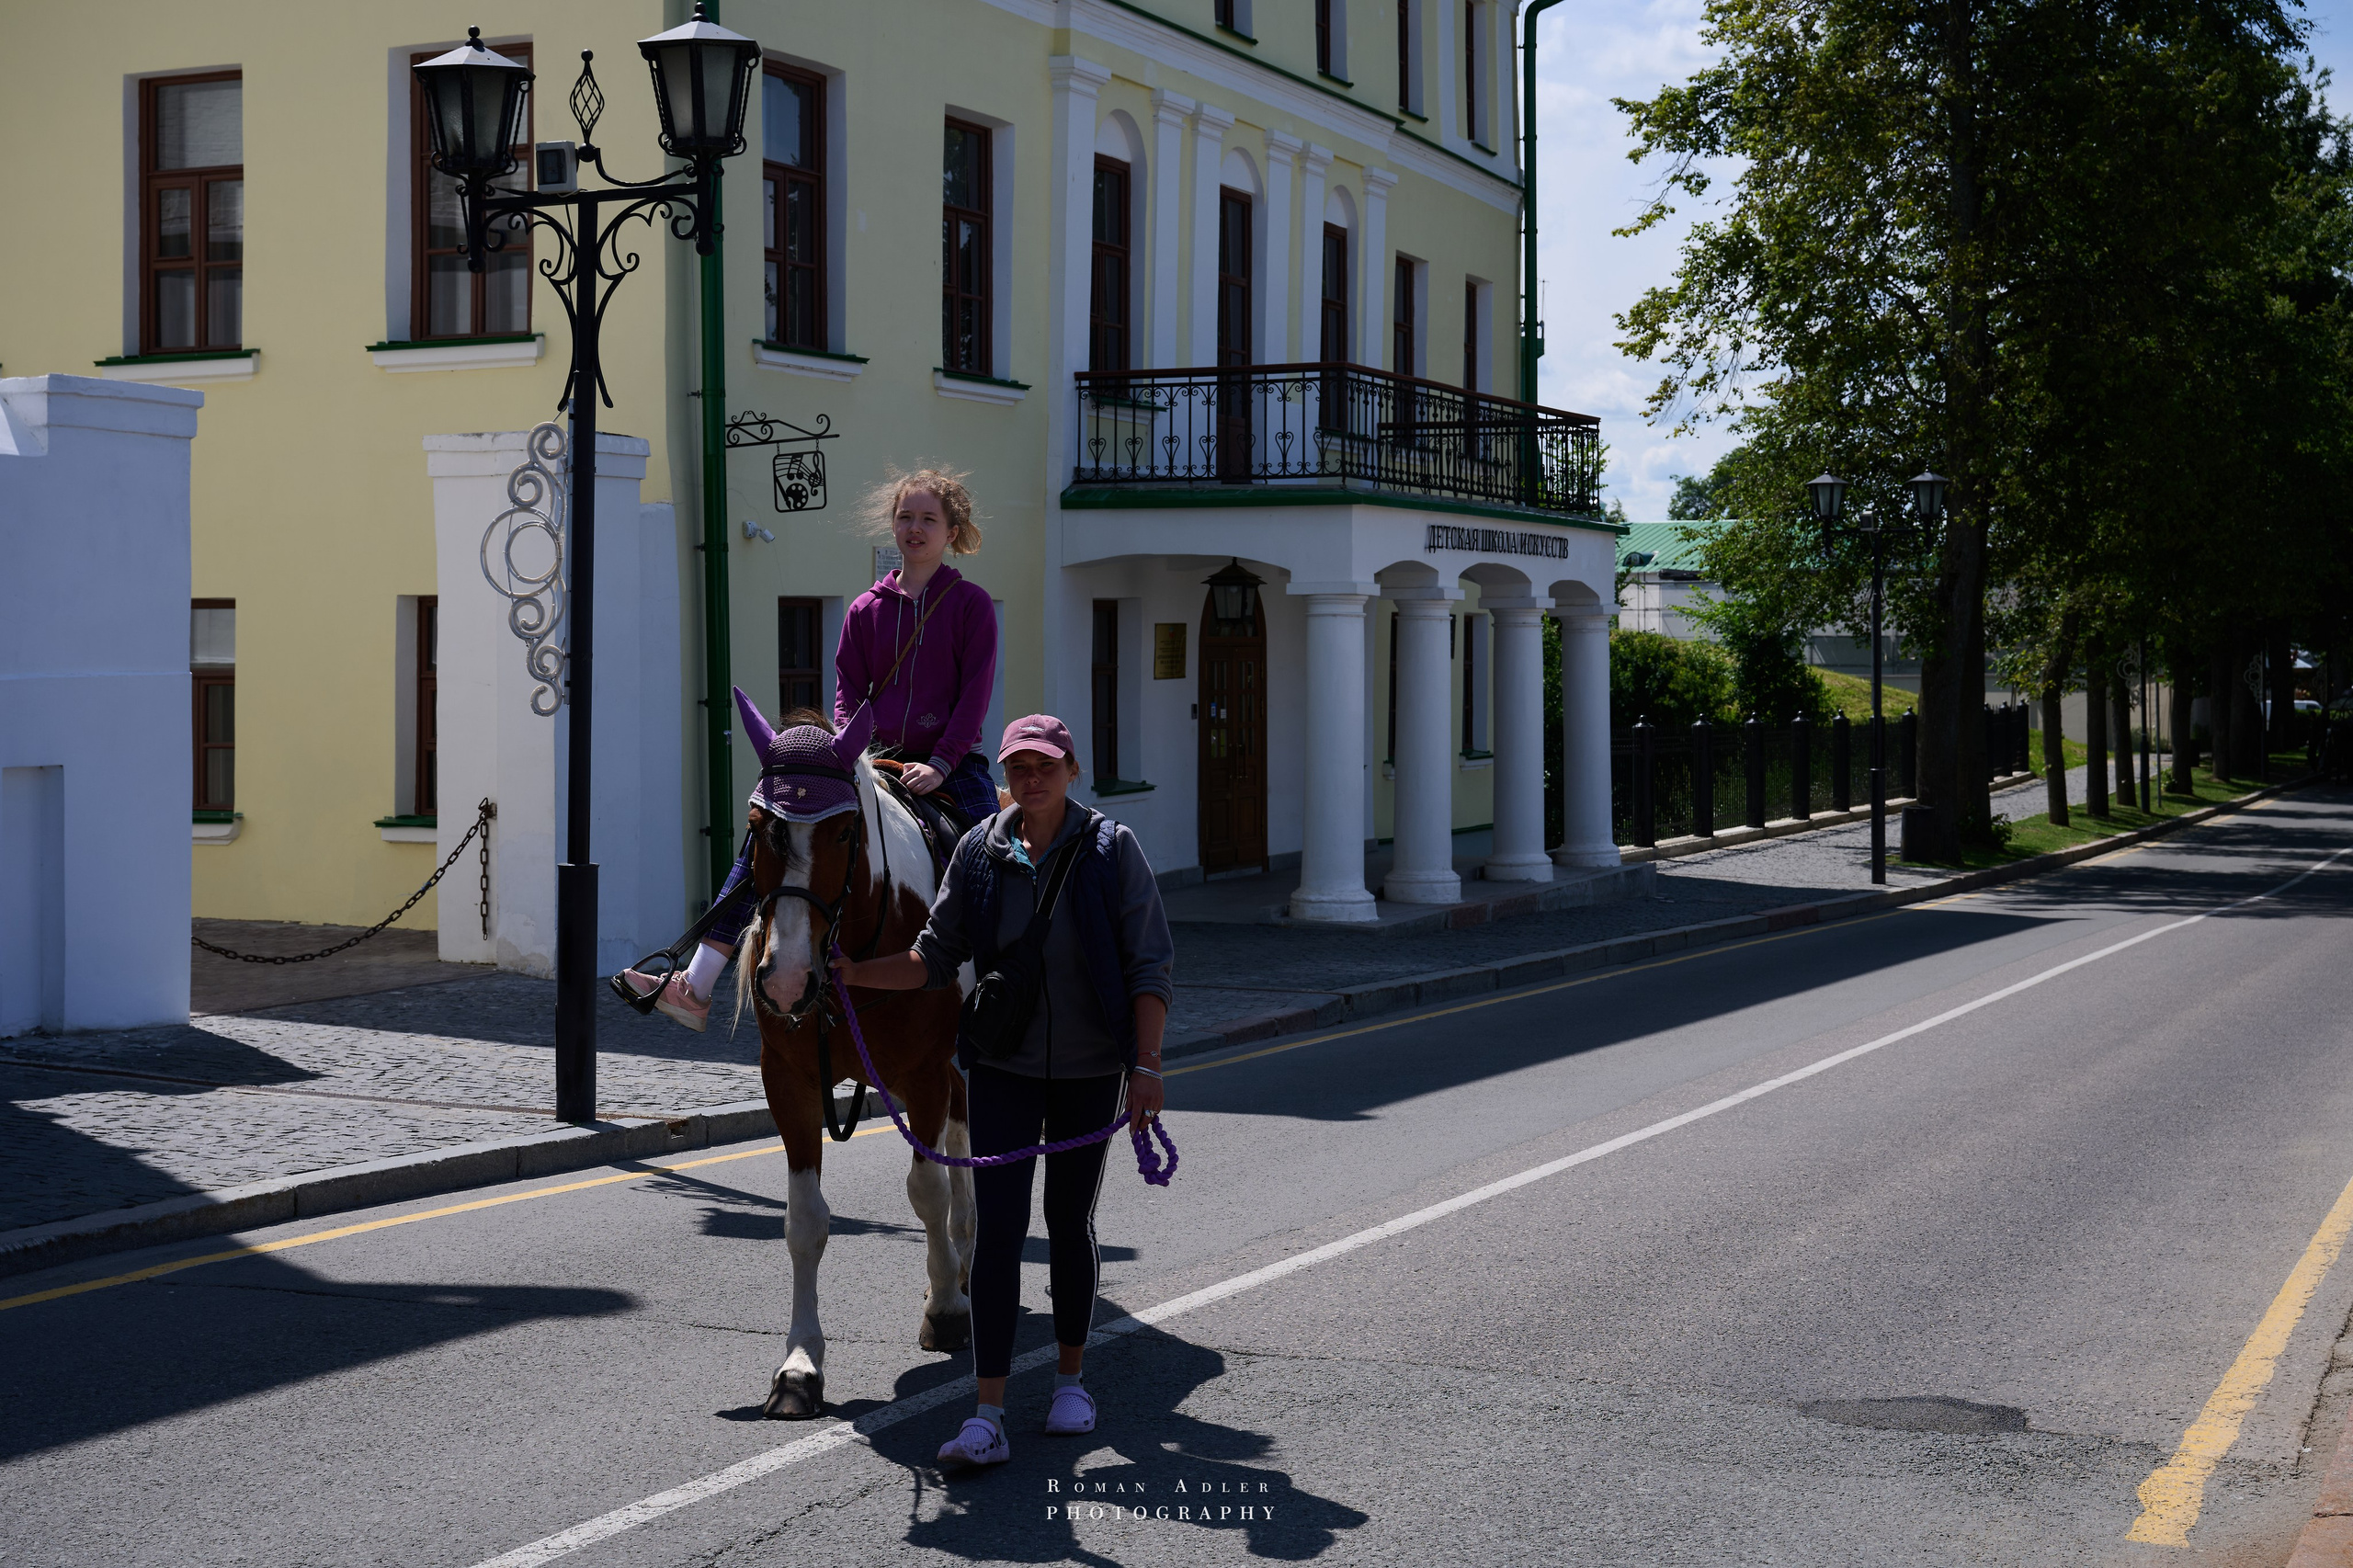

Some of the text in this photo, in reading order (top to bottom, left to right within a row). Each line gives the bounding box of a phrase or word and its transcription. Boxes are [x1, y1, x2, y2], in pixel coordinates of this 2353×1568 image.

[1428, 525, 1569, 559] ДЕТСКАЯ ШКОЛА ИСКУССТВ
